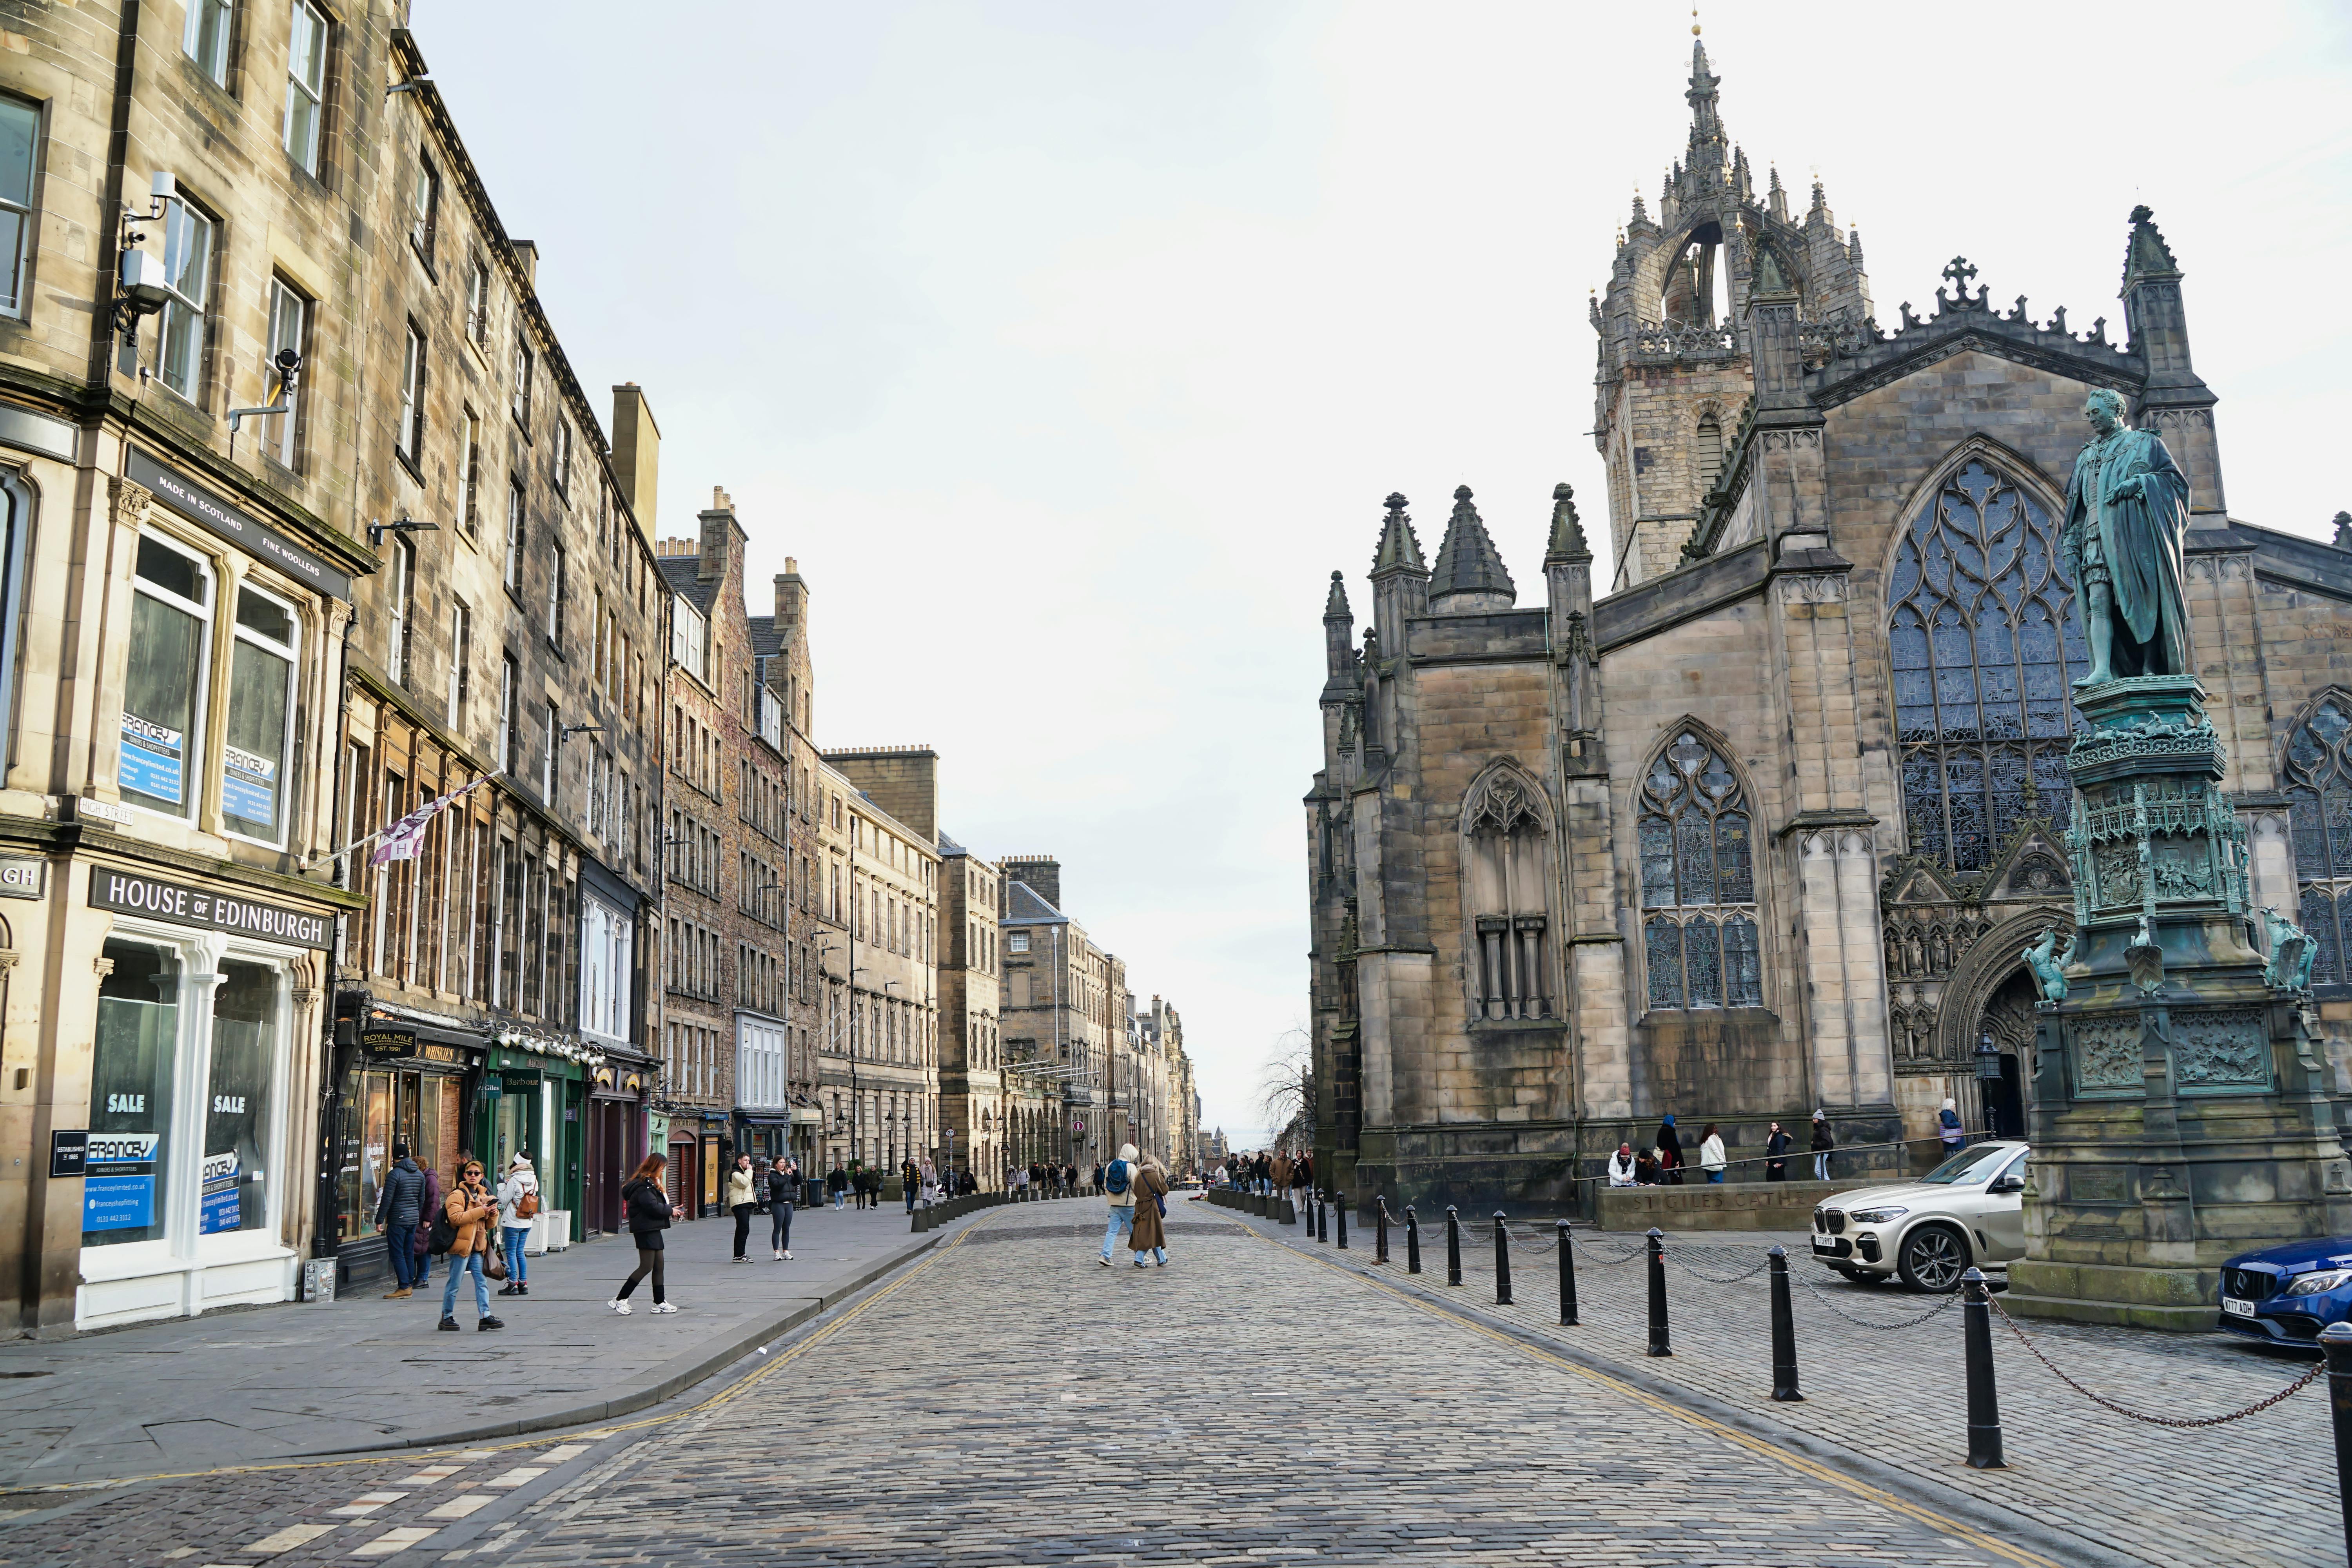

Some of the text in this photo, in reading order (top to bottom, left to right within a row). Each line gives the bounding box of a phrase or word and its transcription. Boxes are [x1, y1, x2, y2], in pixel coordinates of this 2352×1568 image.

[160, 477, 242, 531] MADE IN SCOTLAND
[263, 537, 319, 576] FINE WOOLLENS
[129, 736, 142, 746] JOINERS
[146, 742, 170, 755] SHOPFITTERS
[122, 752, 179, 775] www.franceylimited.co.uk
[229, 769, 241, 778] JOINERS
[245, 774, 265, 786] SHOPFITTERS
[82, 800, 133, 823] HIGH STREET
[109, 876, 323, 942] HOUSE OF EDINBURGH
[364, 1034, 414, 1043] ROYAL MILE
[425, 1045, 454, 1062] WHISKIES
[108, 1094, 145, 1112] SALE
[214, 1095, 245, 1113] SALE
[89, 1141, 149, 1161] FRANCEY
[85, 1183, 145, 1192] www.franceylimited.co.uk
[214, 1180, 234, 1191] SHOPFITTERS
[96, 1199, 139, 1207] franceyshopfitting
[231, 1205, 240, 1213] 3112
[1634, 1195, 1655, 1209] ST
[1666, 1194, 1722, 1209] GILES
[2239, 1302, 2252, 1315] ADH
